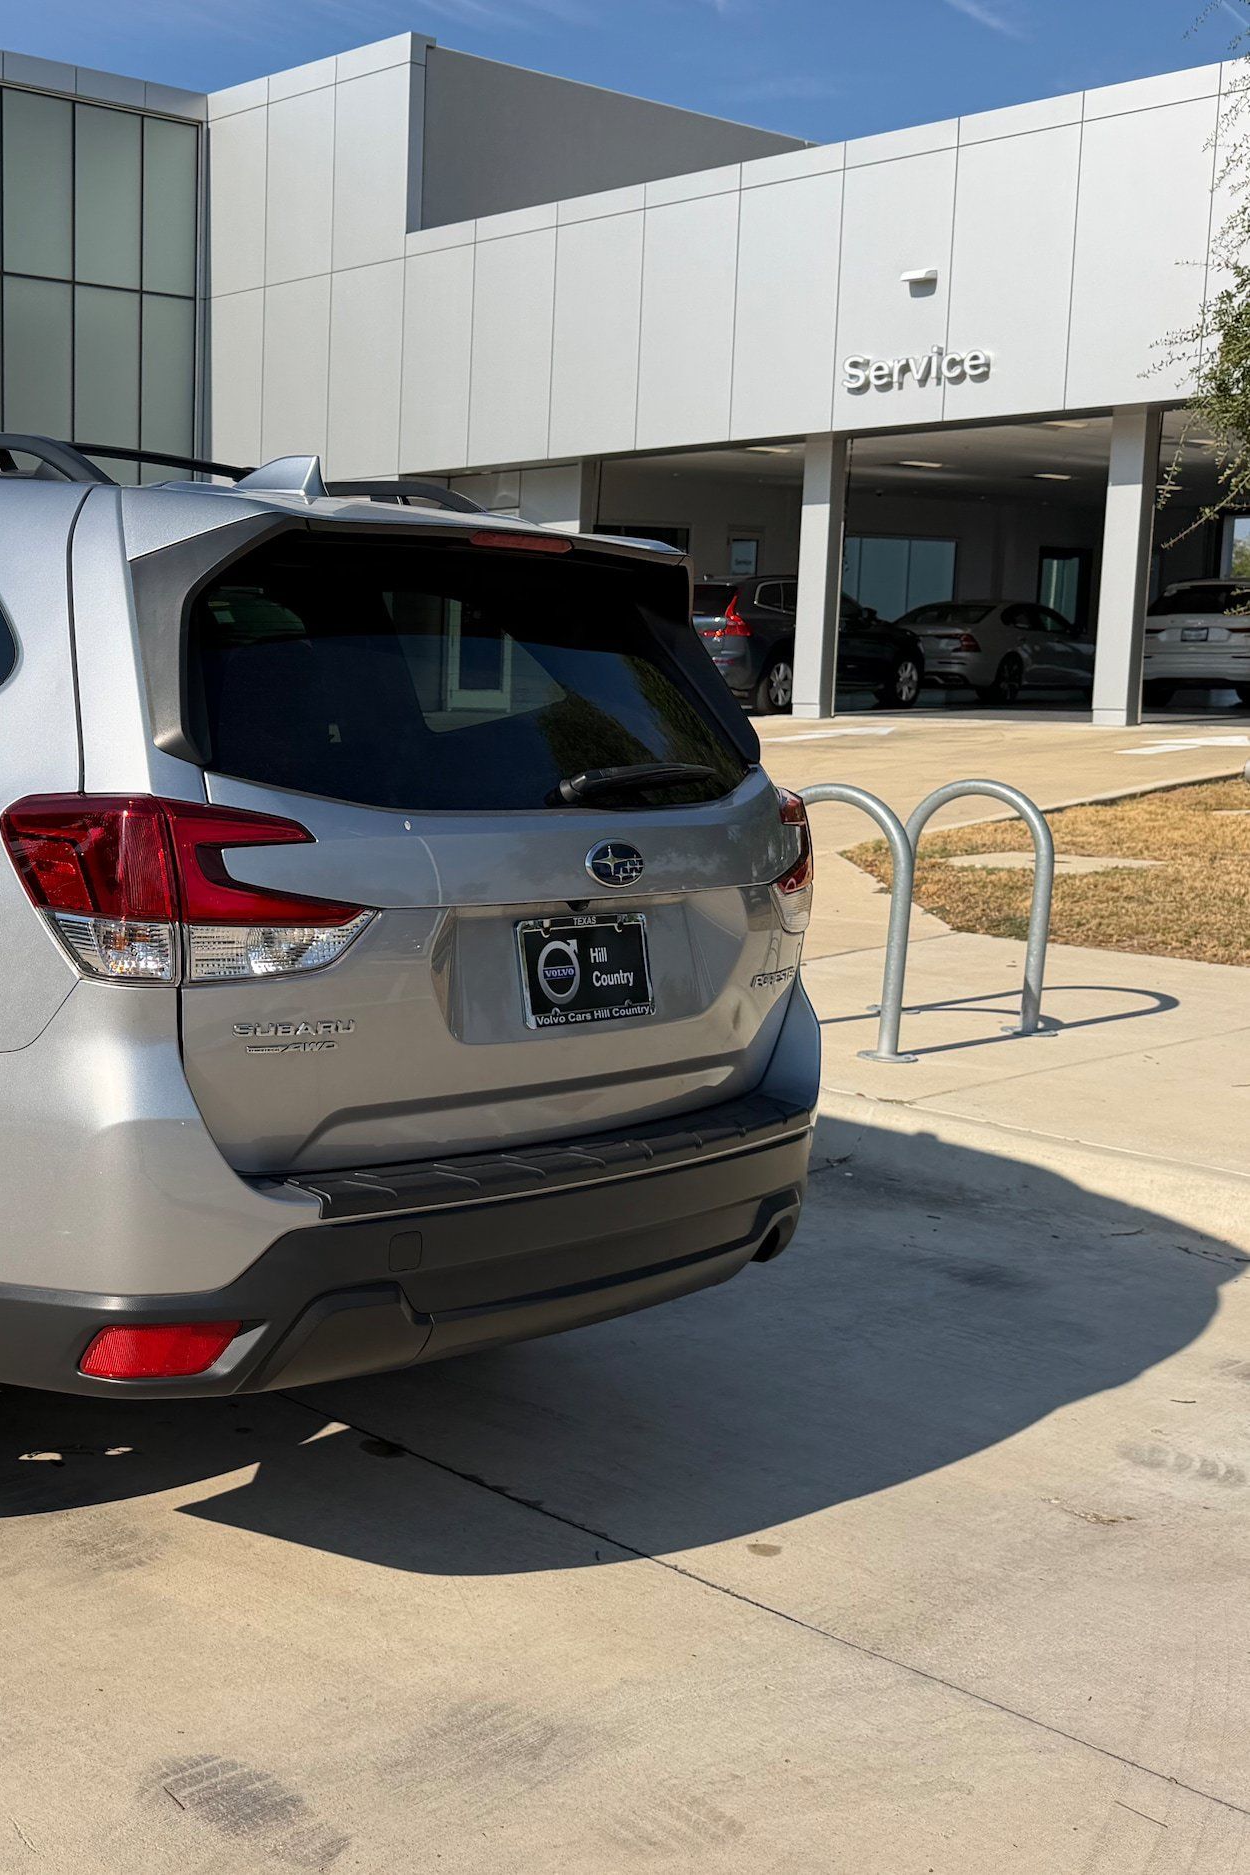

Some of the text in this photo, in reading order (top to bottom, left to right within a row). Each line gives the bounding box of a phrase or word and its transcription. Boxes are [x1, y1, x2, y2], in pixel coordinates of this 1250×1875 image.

[842, 344, 990, 390] Service
[573, 916, 597, 926] TEXAS
[589, 947, 608, 963] Hill
[543, 967, 575, 978] VOLVO
[592, 969, 634, 987] Country
[537, 1004, 650, 1026] Volvo Cars Hill Country
[233, 1019, 356, 1037] SUBARU
[282, 1040, 339, 1052] AWD
